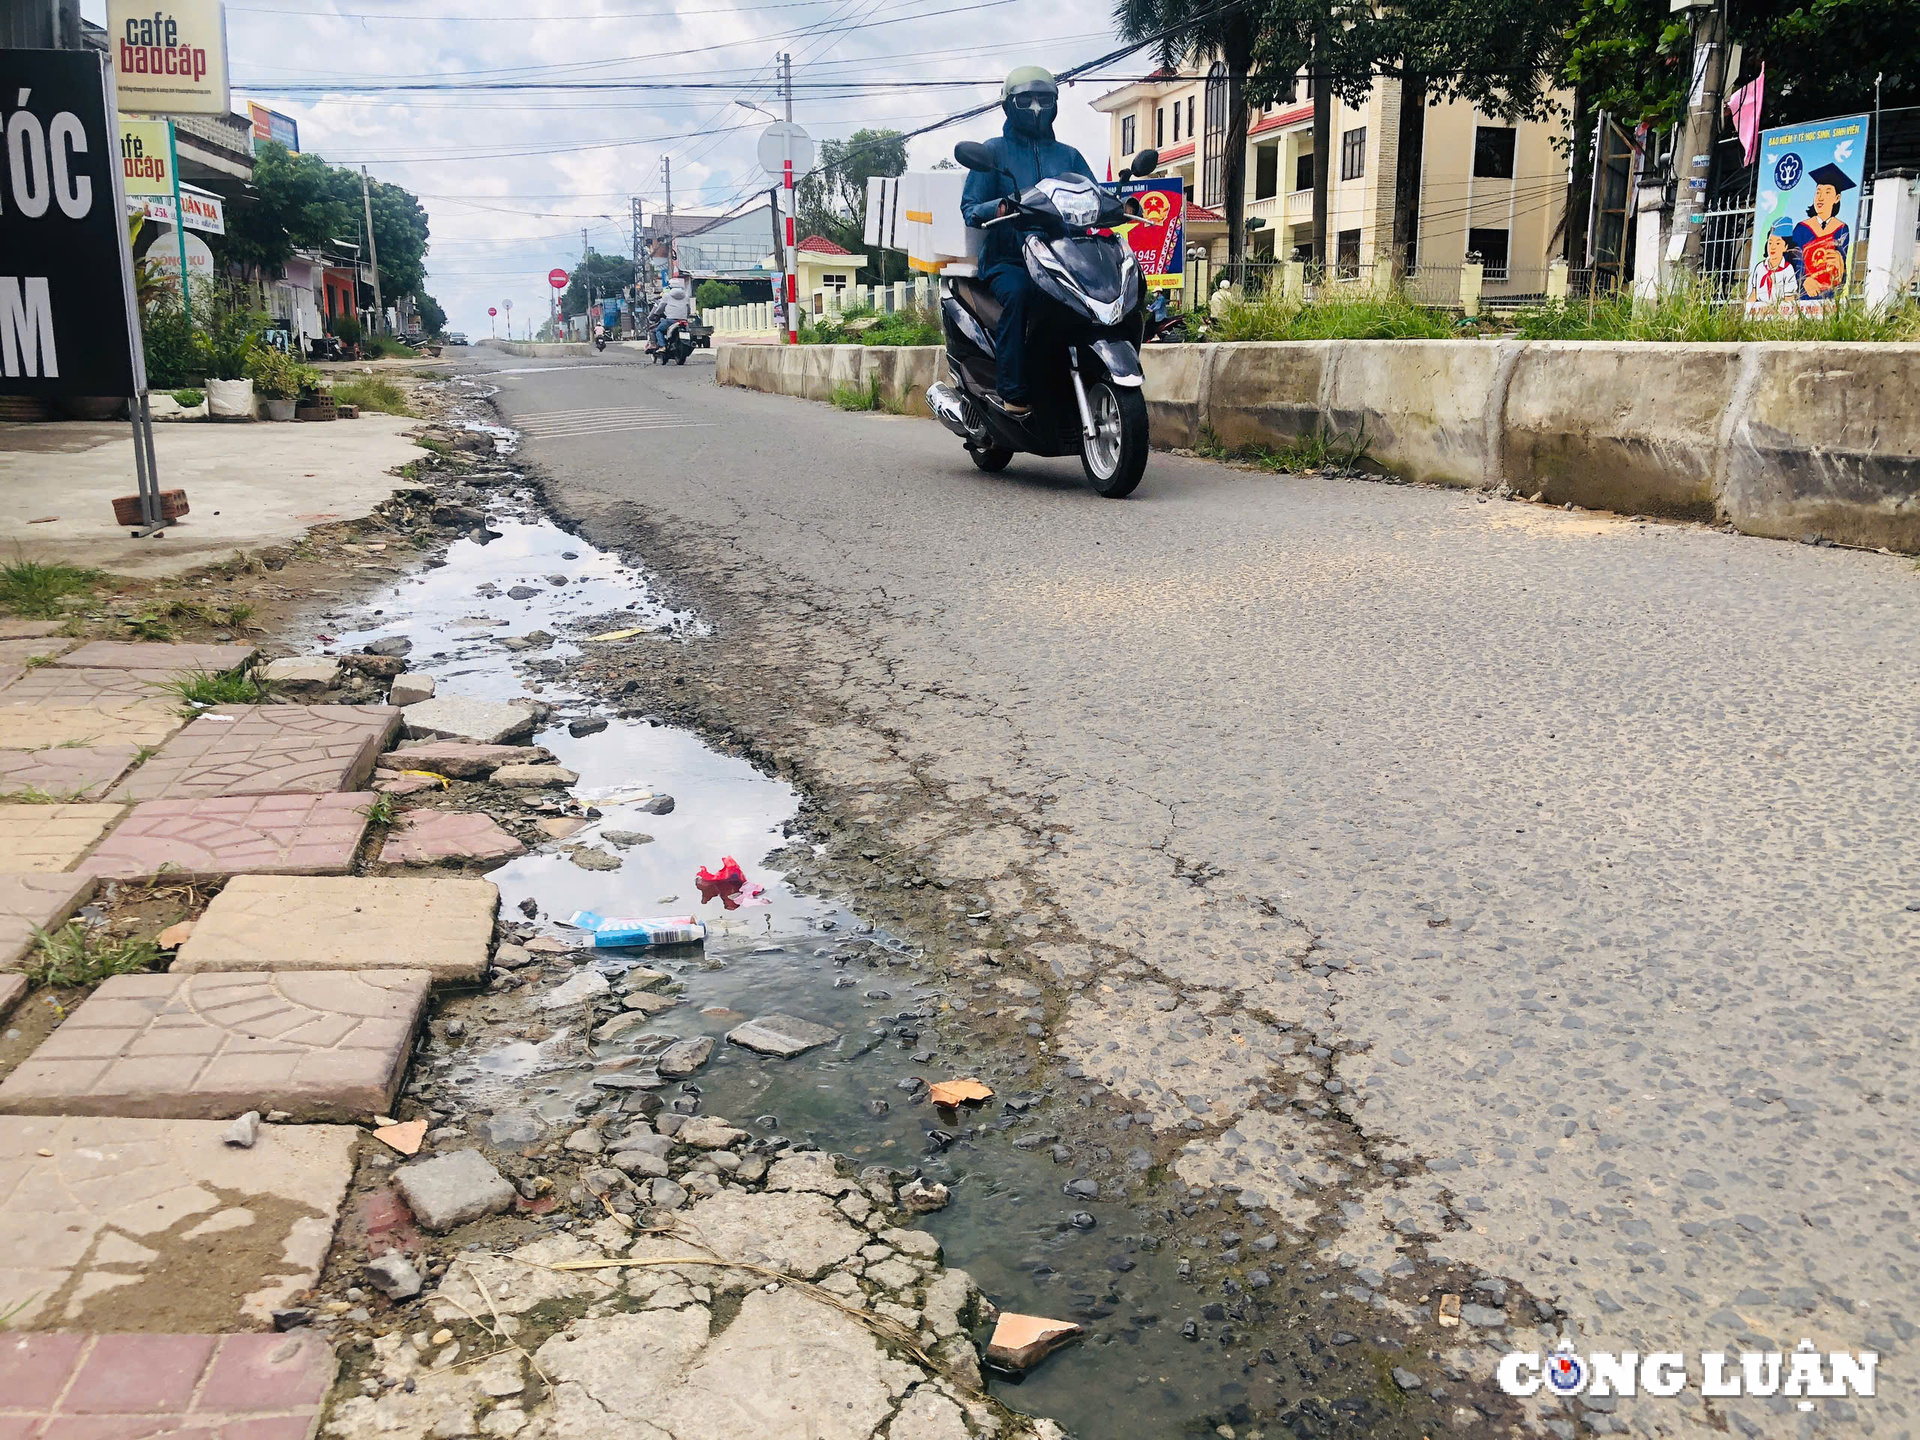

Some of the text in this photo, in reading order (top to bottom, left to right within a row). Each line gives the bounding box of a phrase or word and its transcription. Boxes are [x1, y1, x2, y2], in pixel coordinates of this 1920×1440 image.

[126, 12, 177, 47] café
[120, 38, 206, 82] baocấp
[1833, 127, 1846, 138] SINH
[0, 88, 93, 219] ÓC
[124, 156, 165, 182] ocấp
[180, 196, 201, 216] UÂN
[1140, 264, 1156, 275] 24
[0, 276, 59, 378] M
